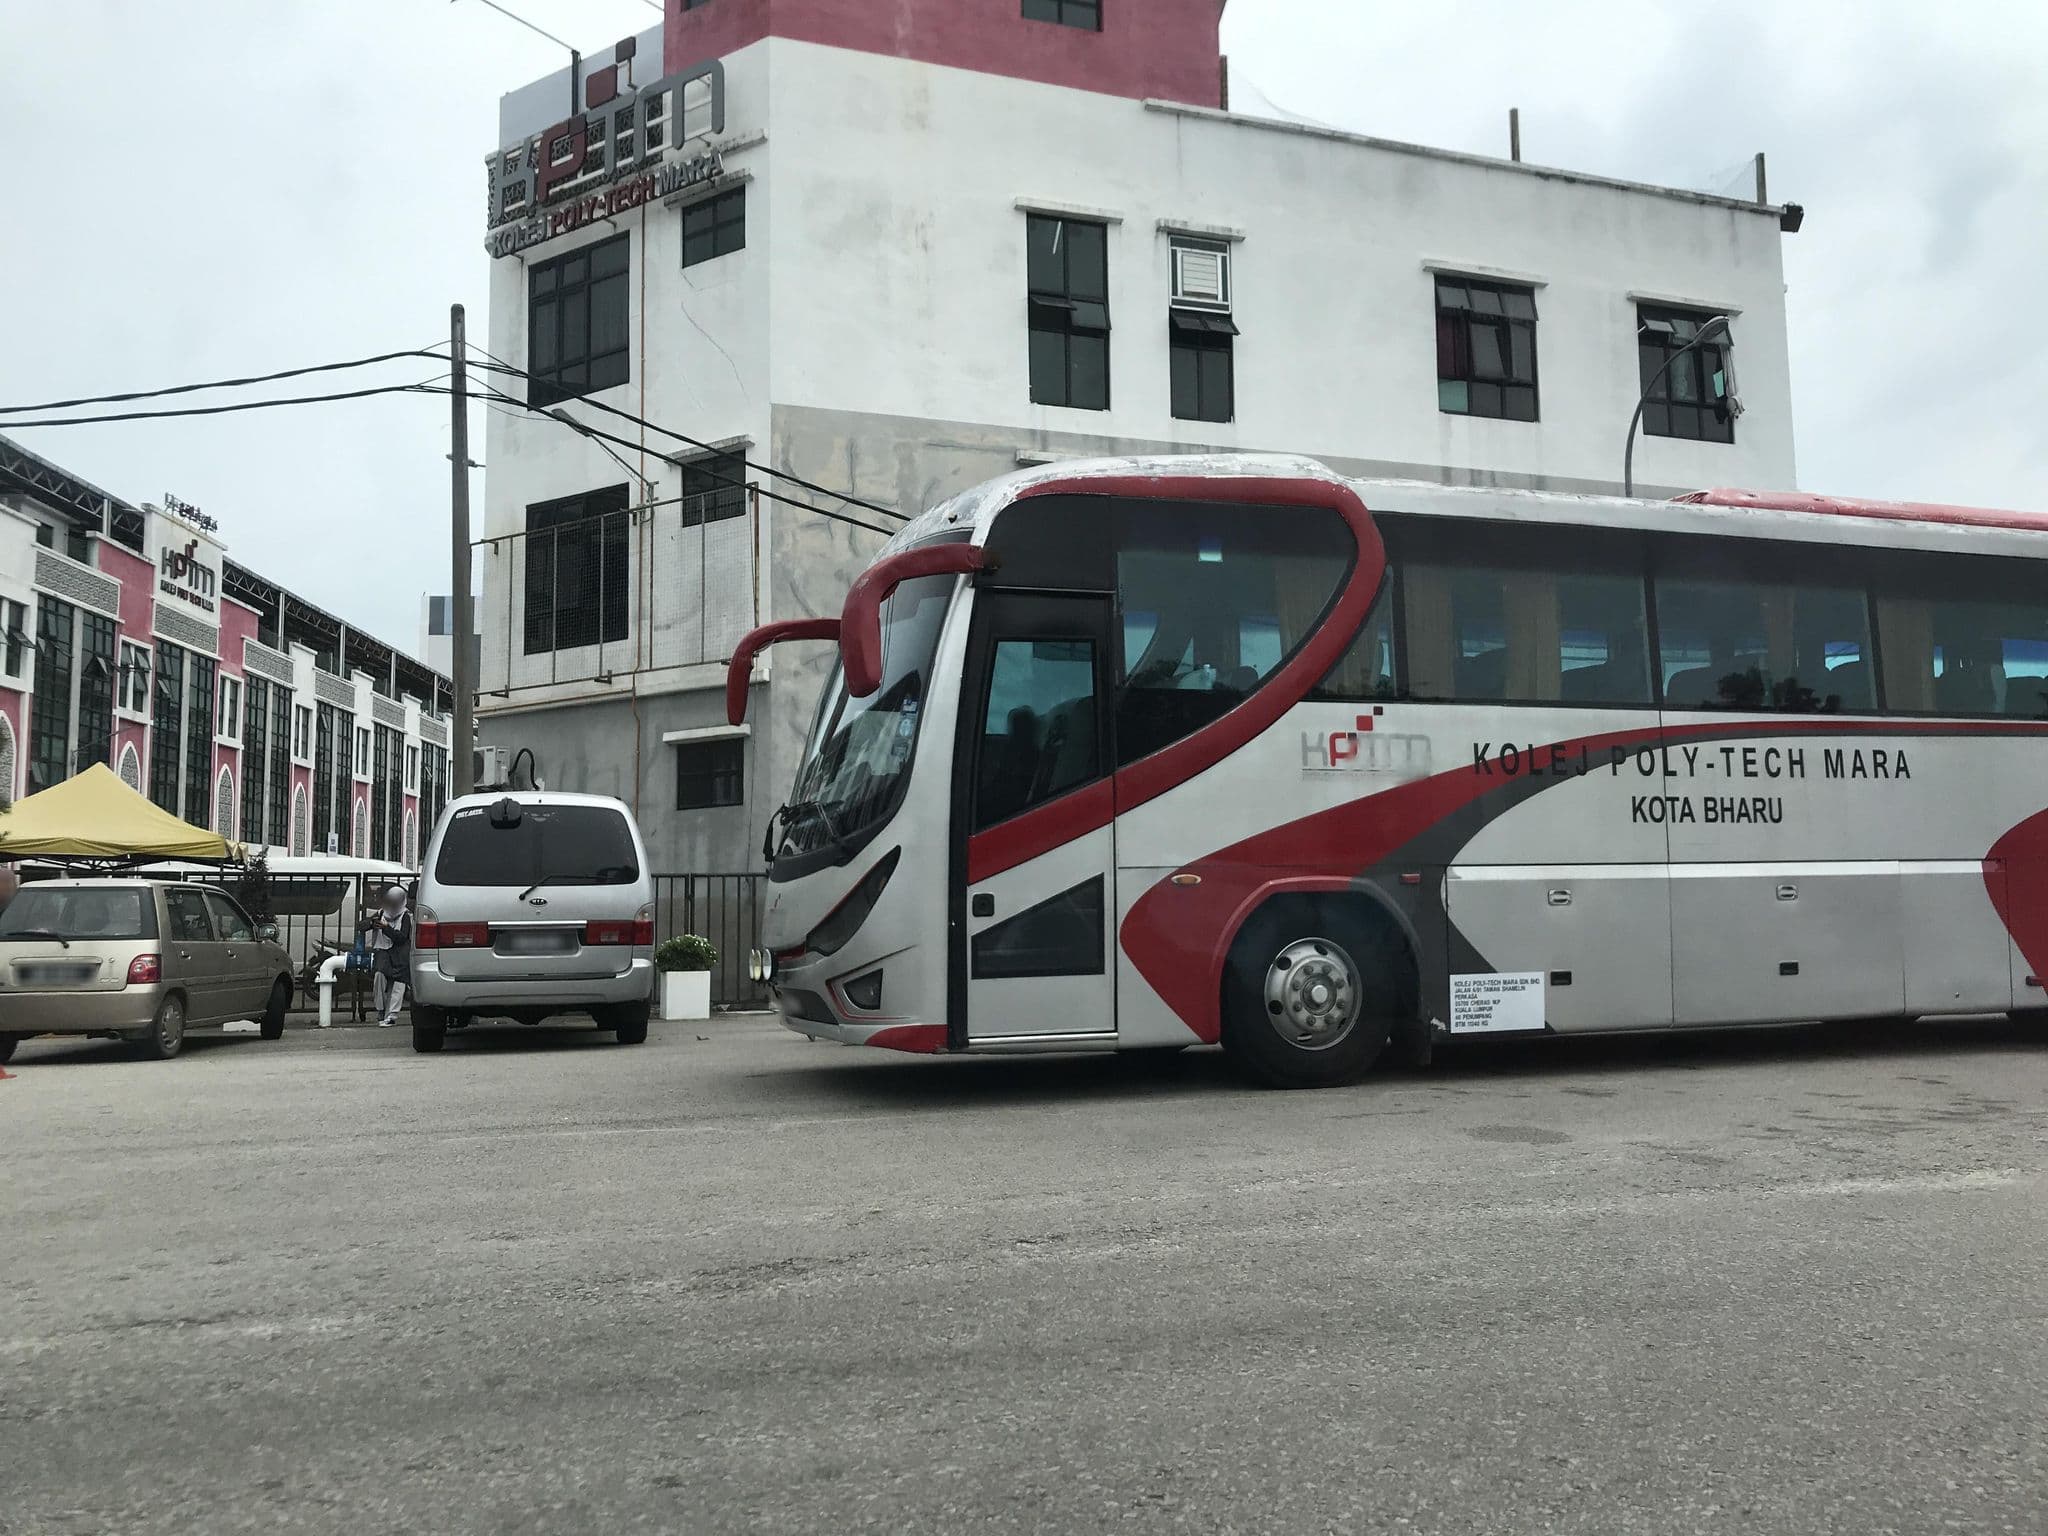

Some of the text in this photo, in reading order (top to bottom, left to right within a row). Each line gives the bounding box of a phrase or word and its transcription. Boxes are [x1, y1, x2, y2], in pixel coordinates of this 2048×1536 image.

[492, 149, 724, 255] KOLEJ POLY-TECH MARA
[1473, 742, 1911, 779] KOLEJ POLY-TECH MARA
[1631, 796, 1783, 823] KOTA BHARU
